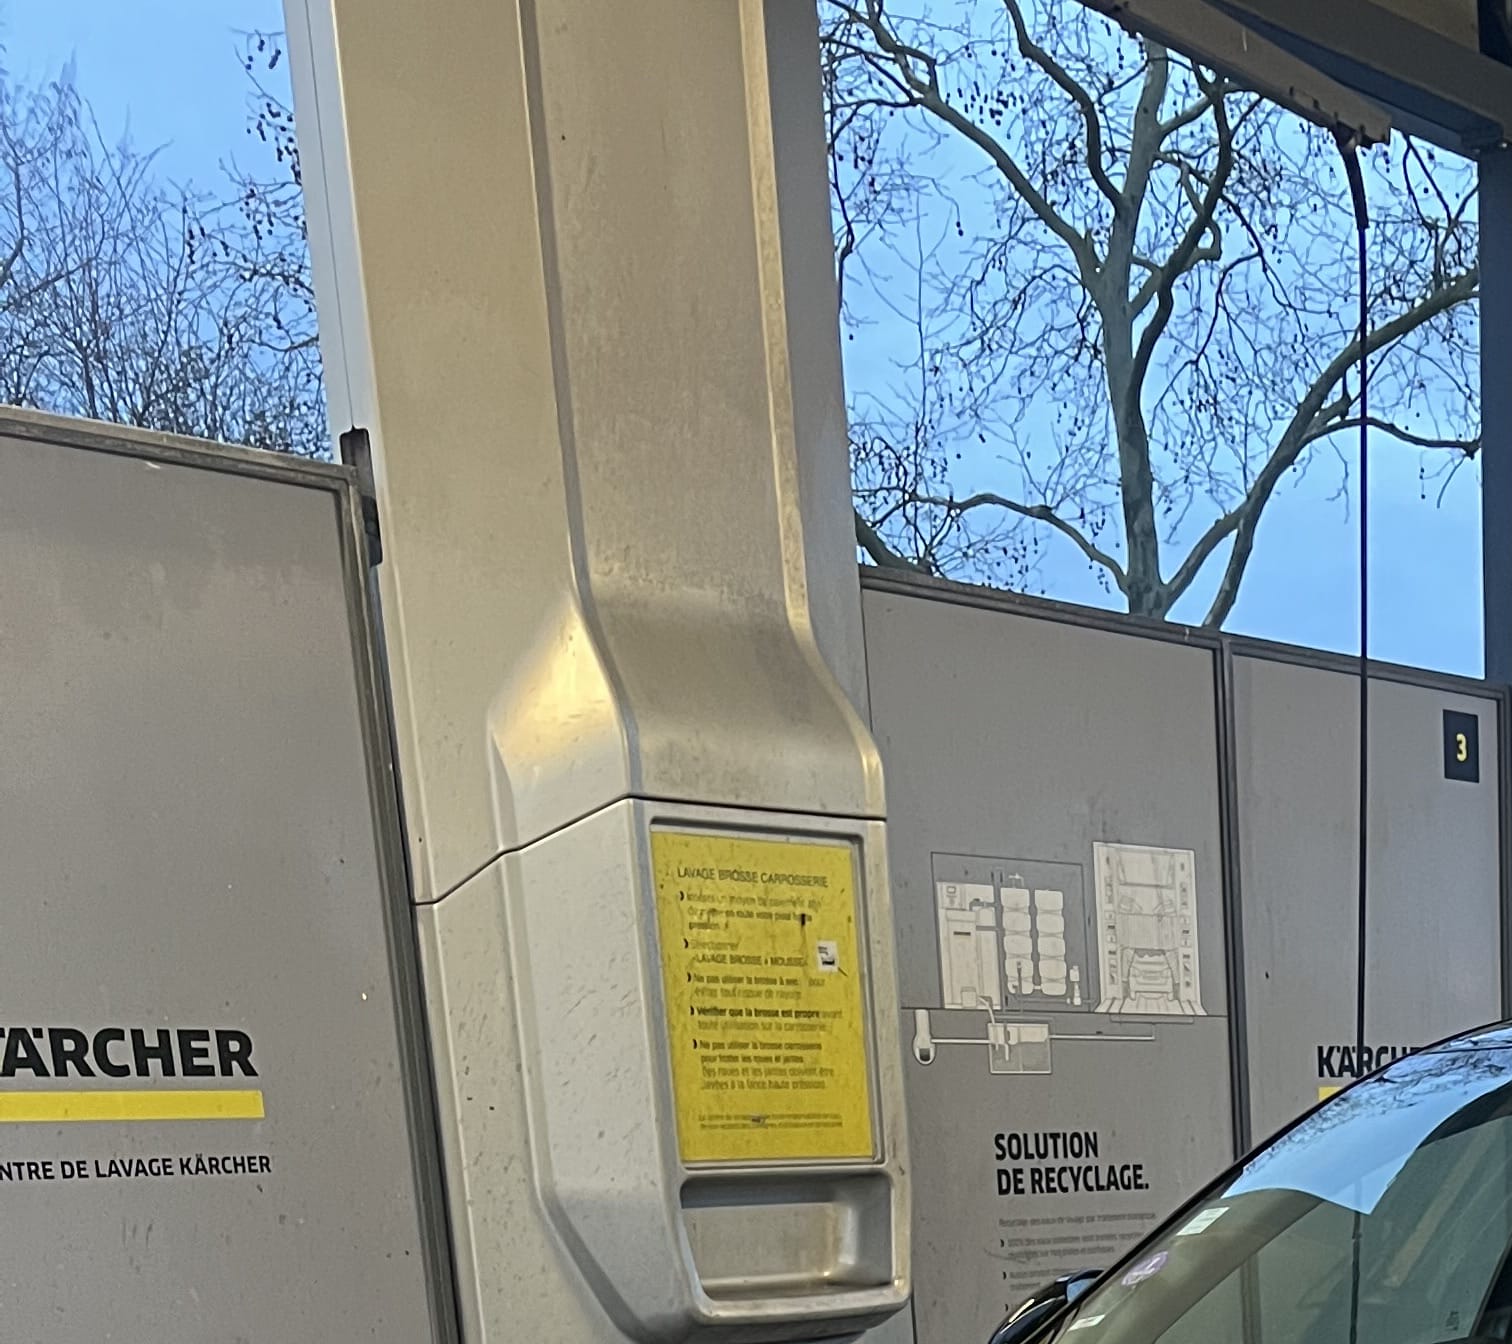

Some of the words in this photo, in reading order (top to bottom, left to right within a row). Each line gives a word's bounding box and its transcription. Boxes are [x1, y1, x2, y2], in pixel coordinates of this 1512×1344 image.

[1456, 733, 1467, 762] 3
[677, 867, 715, 880] LAVAGE
[718, 869, 759, 884] BROSSE
[0, 1028, 259, 1077] ÄRCHER
[994, 1131, 1099, 1161] SOLUTION
[61, 1160, 90, 1180] DE
[94, 1158, 175, 1178] LAVAGE
[179, 1153, 272, 1176] KÄRCHER
[996, 1167, 1025, 1196] DE
[1030, 1164, 1150, 1195] RECYCLAGE.
